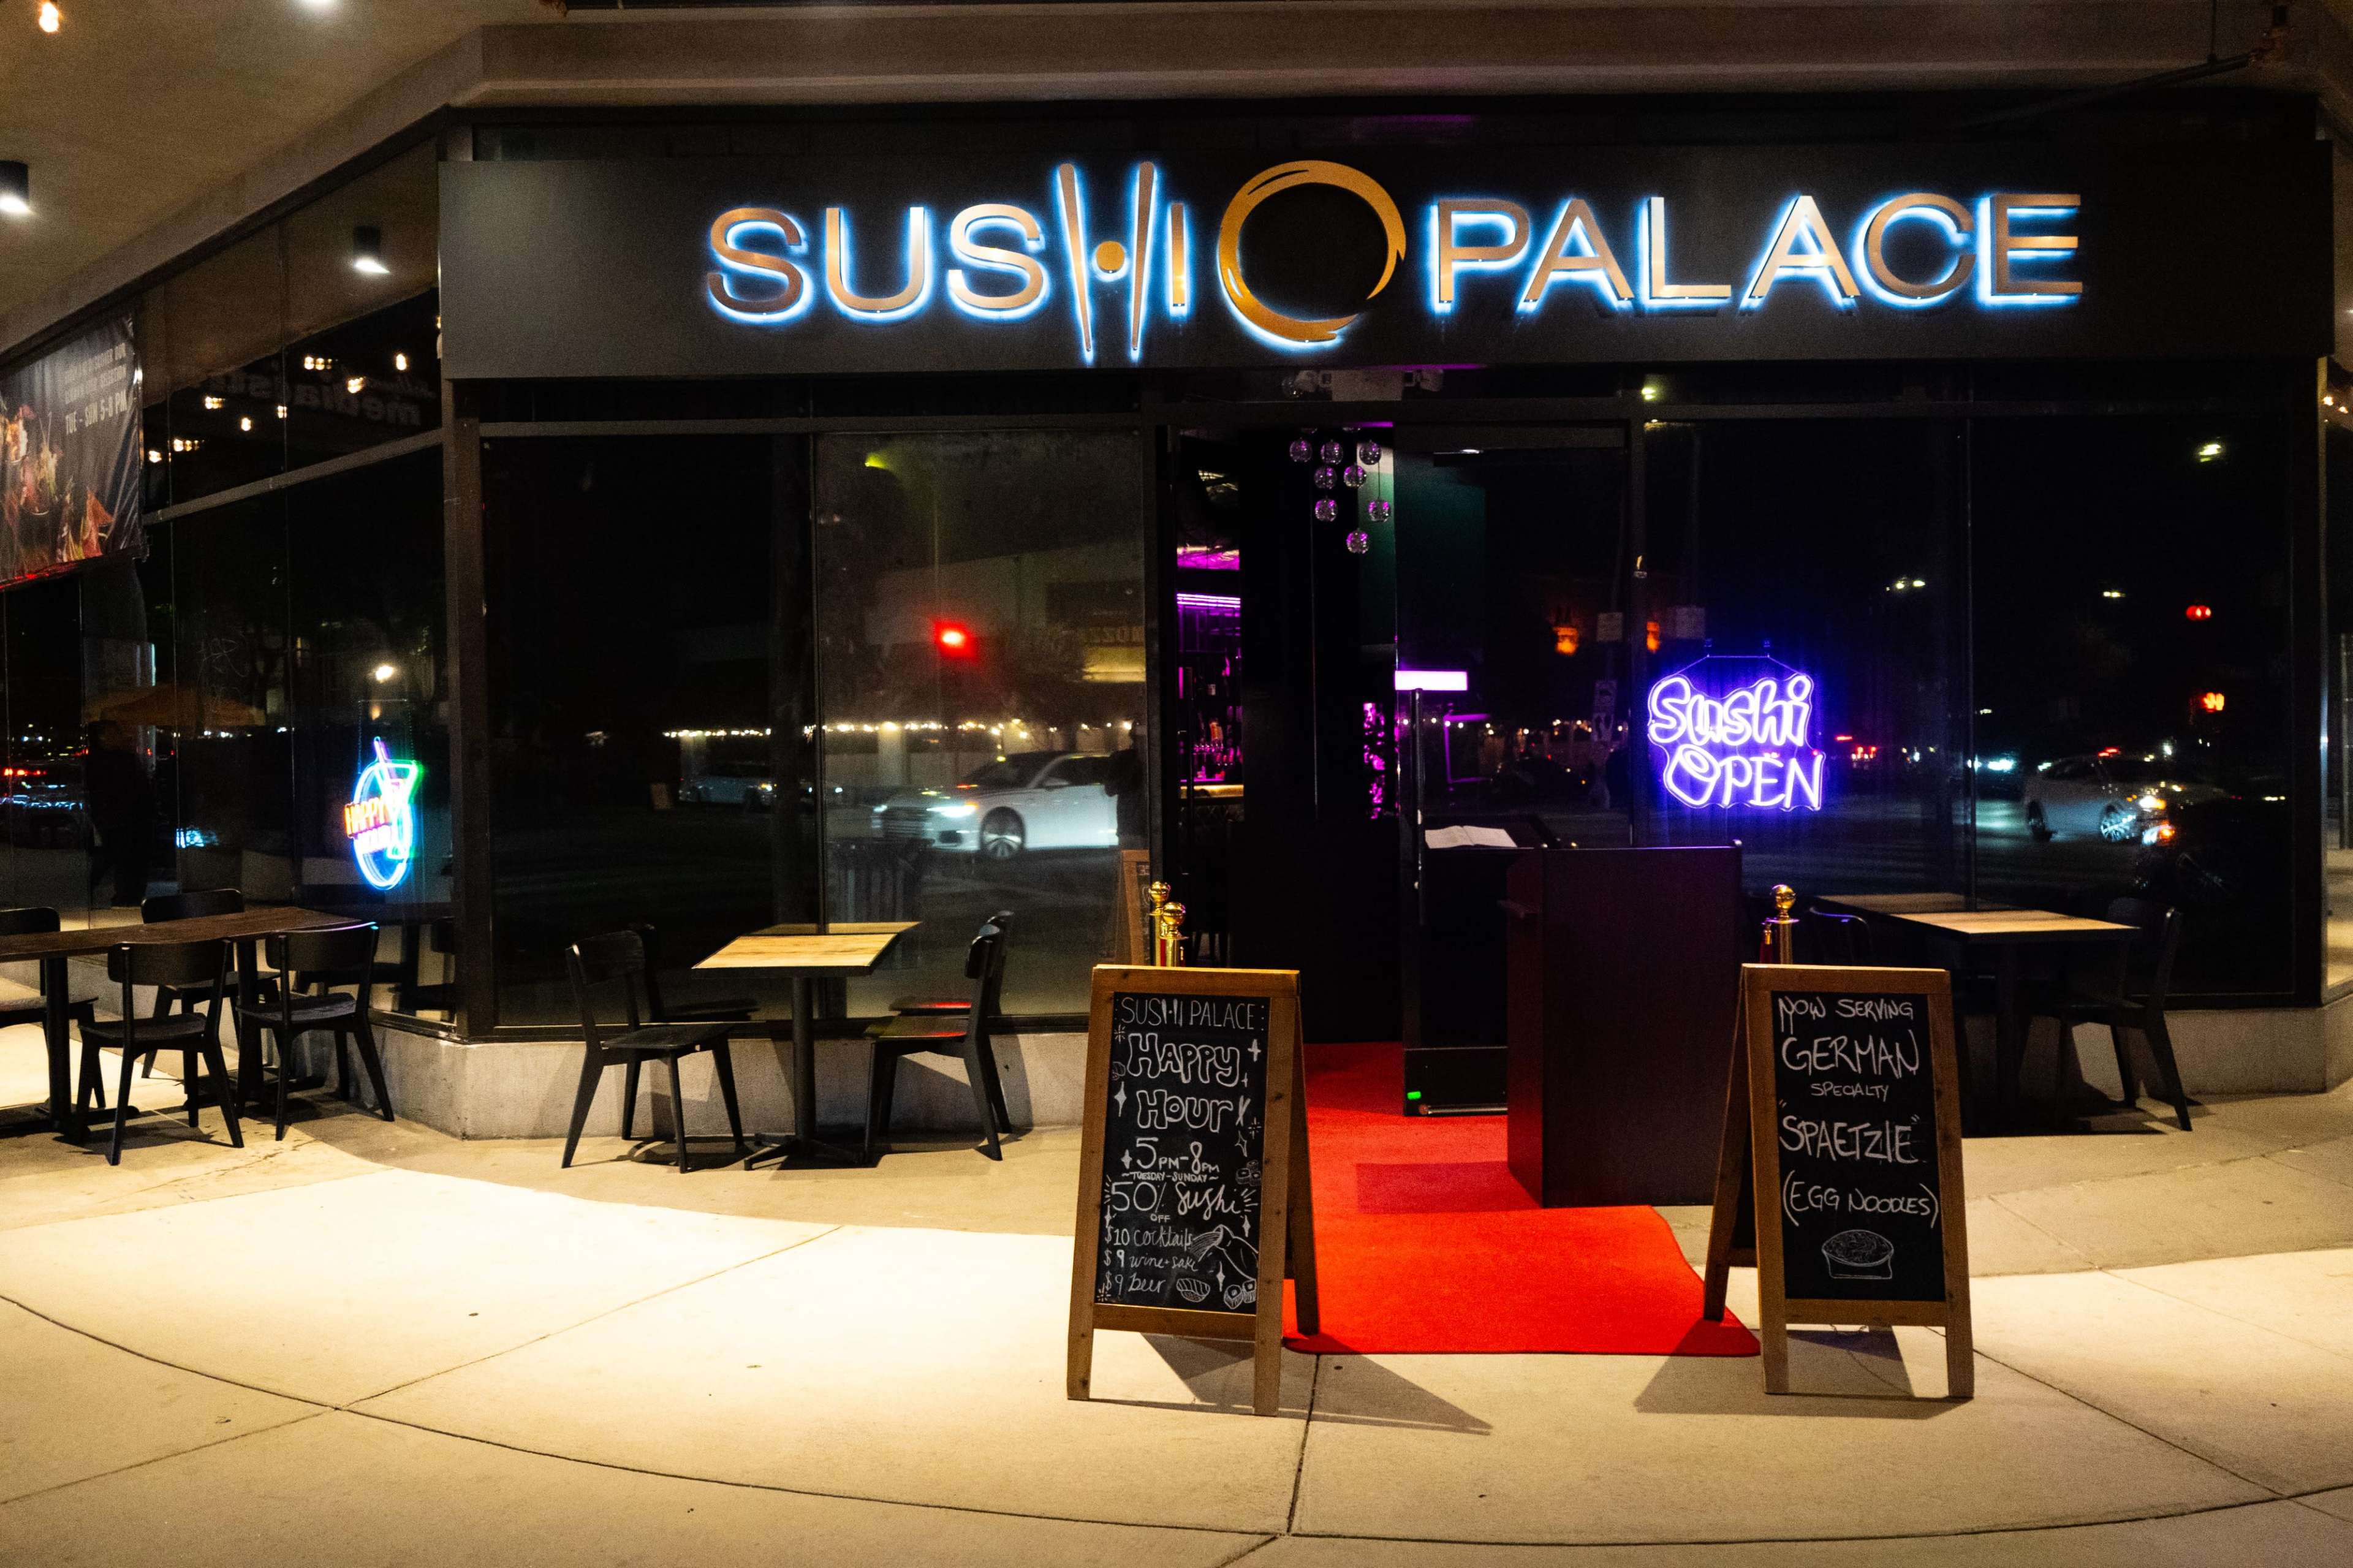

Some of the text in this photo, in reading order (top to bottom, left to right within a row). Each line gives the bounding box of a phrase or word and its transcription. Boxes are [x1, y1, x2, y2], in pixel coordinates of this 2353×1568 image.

[707, 162, 2083, 353] SUSHI PALACE
[1648, 676, 1809, 746] Sushi
[1666, 743, 1824, 809] OPEN
[1121, 997, 1255, 1030] SUSHI PALACE
[1778, 996, 1914, 1034] NOW SERVING
[1782, 1029, 1919, 1079] GERMAN
[1811, 1081, 1889, 1102] SPECIALTY
[1150, 1213, 1170, 1222] OFF
